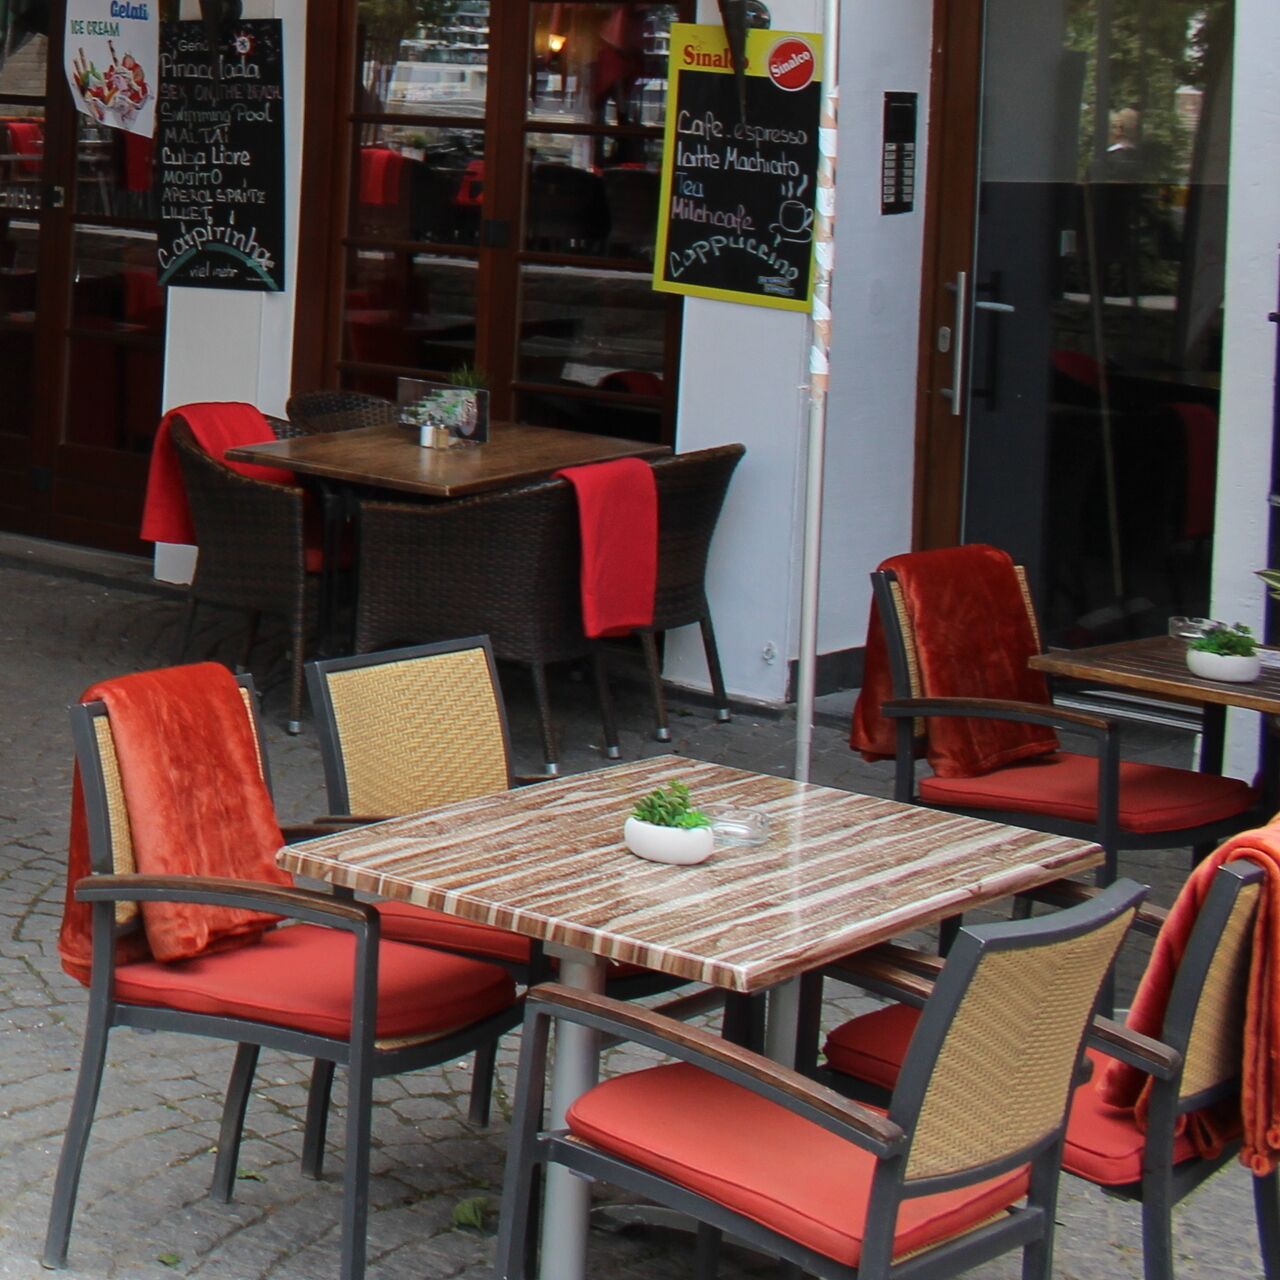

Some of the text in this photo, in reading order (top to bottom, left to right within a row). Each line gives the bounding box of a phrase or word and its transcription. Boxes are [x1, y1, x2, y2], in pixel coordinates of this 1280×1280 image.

[71, 20, 120, 37] ICE CREAM
[770, 51, 811, 78] Sinalco
[231, 103, 273, 122] Pool
[734, 123, 808, 149] espresso
[162, 146, 206, 165] Cuba
[676, 172, 704, 197] Tea
[163, 187, 213, 203] APEROL
[161, 205, 213, 220] LILLET
[670, 235, 799, 280] Cappuccino
